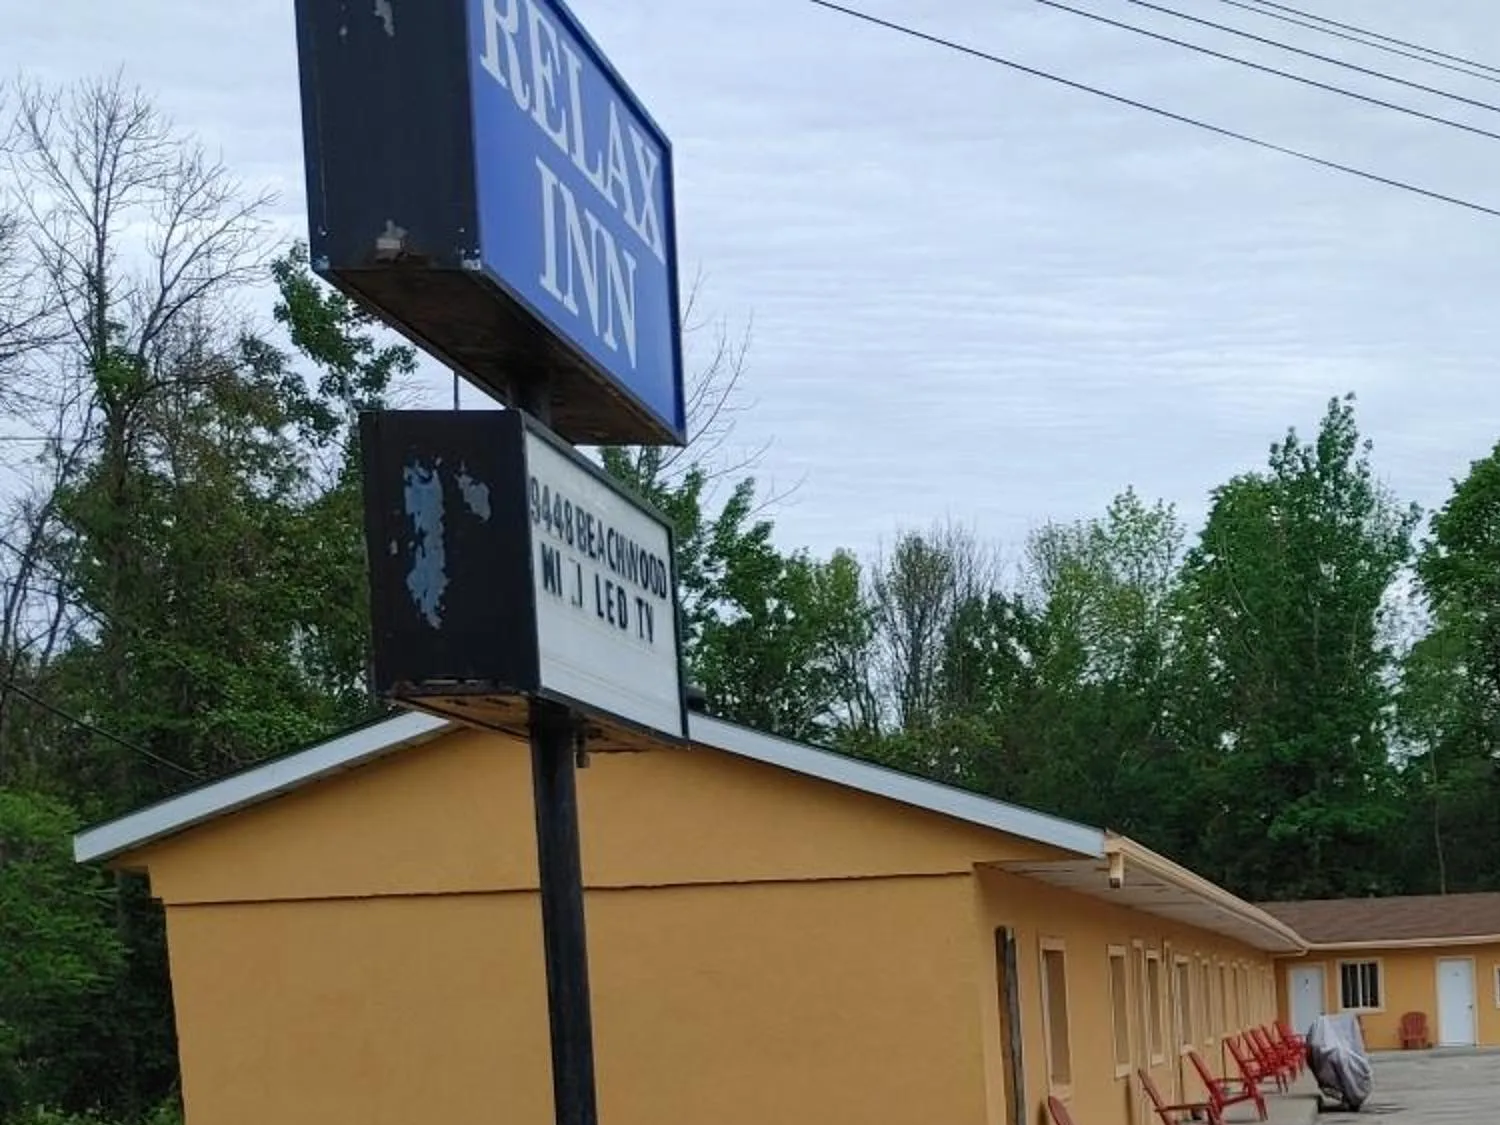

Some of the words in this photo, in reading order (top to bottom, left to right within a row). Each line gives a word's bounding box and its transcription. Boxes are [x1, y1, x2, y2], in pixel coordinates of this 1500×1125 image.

[480, 0, 665, 265] RELAX
[536, 156, 637, 369] INN
[575, 505, 667, 600] BEACHWOOD
[595, 573, 628, 630] LED
[635, 596, 653, 644] TV
